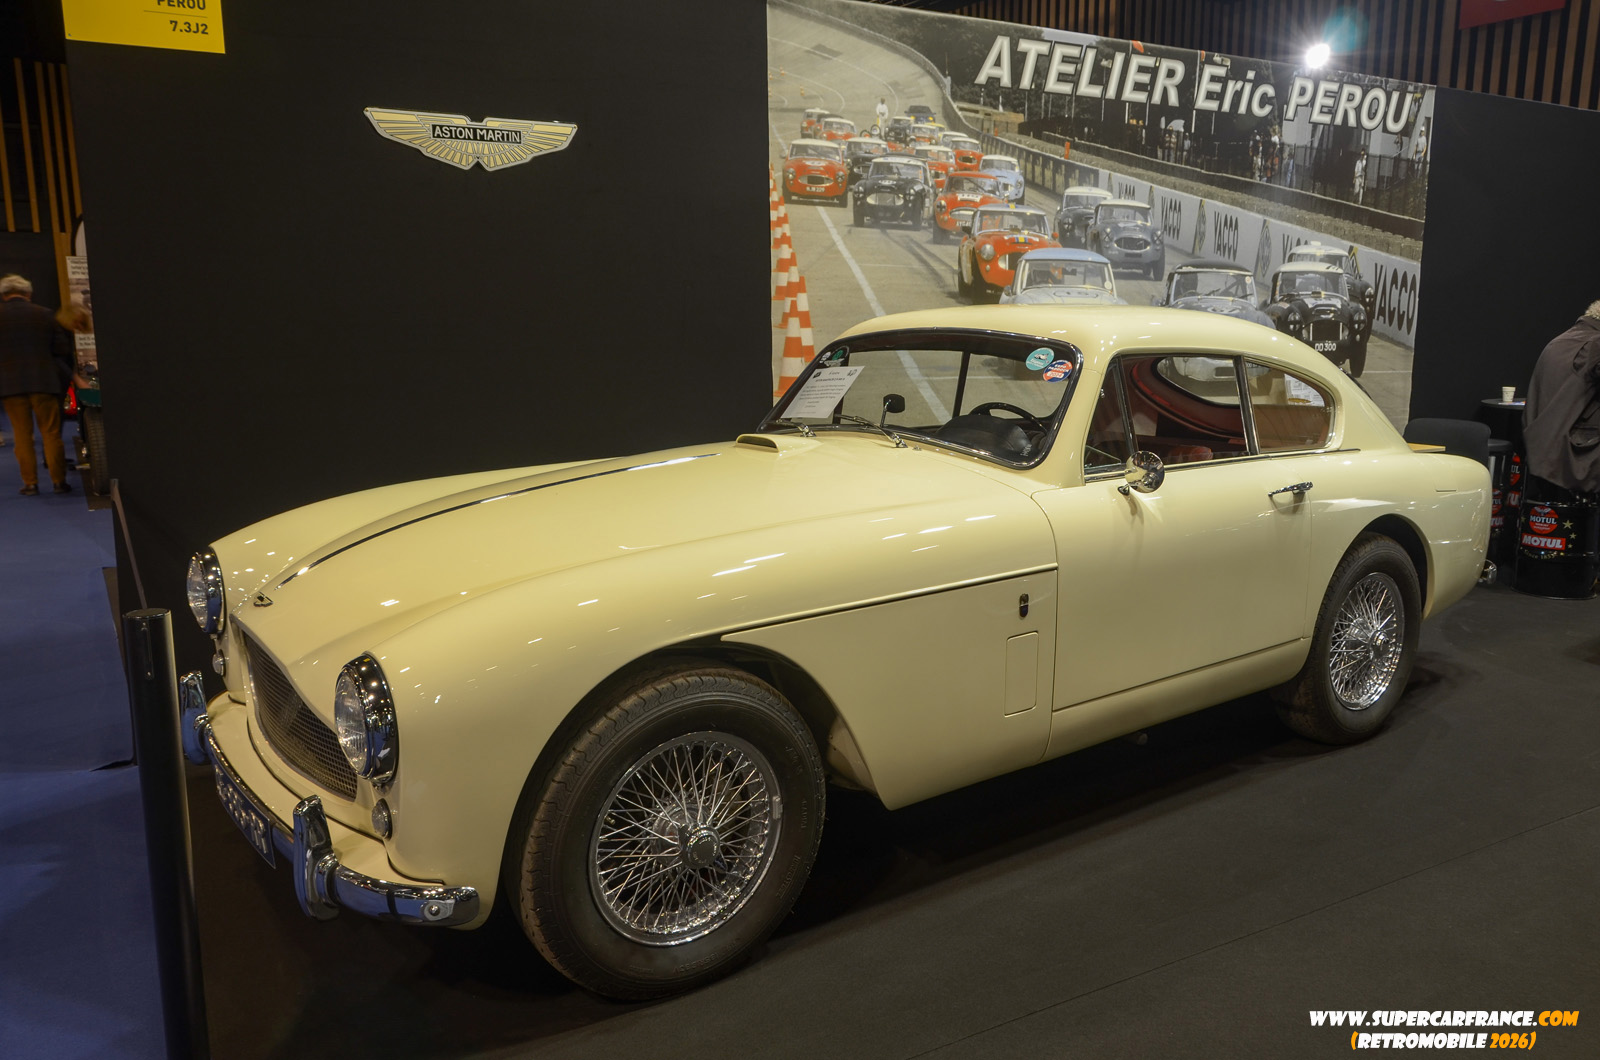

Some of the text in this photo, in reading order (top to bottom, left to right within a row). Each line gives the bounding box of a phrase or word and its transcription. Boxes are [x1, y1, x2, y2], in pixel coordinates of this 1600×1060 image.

[169, 20, 209, 35] 7.3J2
[974, 35, 1414, 133] ATELIER Eric PEROU
[434, 126, 520, 142] ASTON MARTIN
[1214, 211, 1239, 262] YACCO
[1374, 262, 1417, 336] YACCO
[1530, 515, 1557, 525] MOTUL
[1522, 534, 1563, 549] MOTUL
